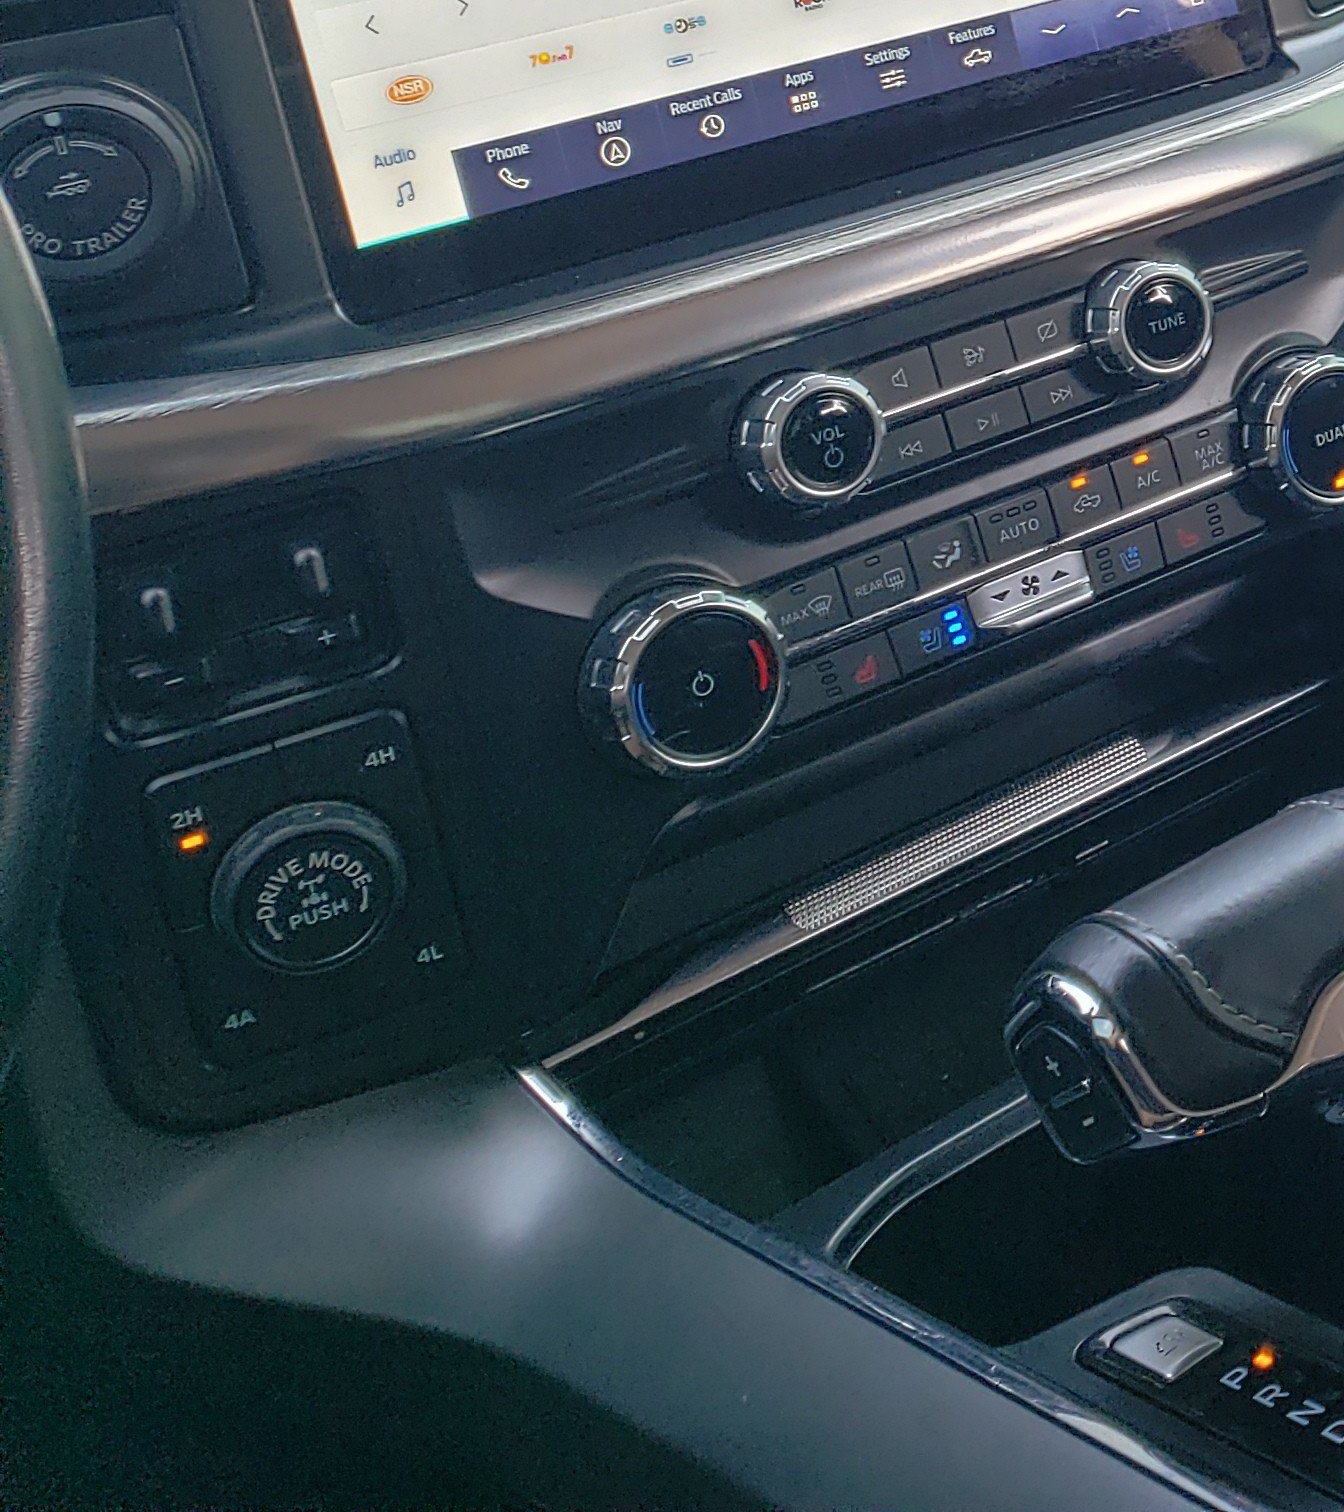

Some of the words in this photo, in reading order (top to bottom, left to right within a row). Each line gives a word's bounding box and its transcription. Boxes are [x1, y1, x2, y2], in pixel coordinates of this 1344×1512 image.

[949, 23, 996, 46] Features
[865, 44, 910, 68] Settings
[393, 79, 423, 98] NSR
[785, 68, 816, 90] Apps
[670, 94, 712, 117] Recent
[713, 86, 743, 106] Calls
[596, 117, 623, 136] Nav
[374, 146, 417, 169] Audio
[486, 140, 531, 164] Phone
[72, 196, 149, 256] TRAILER
[1147, 312, 1187, 335] TUNE
[809, 425, 846, 445] VOL
[1194, 441, 1224, 459] MAX
[1201, 452, 1225, 471] A/C
[1136, 468, 1162, 490] A/C
[999, 516, 1041, 542] AUTO
[854, 579, 884, 598] REAR
[780, 607, 810, 626] MAX
[363, 746, 397, 769] 4H
[169, 805, 204, 830] 2H
[256, 857, 305, 922] DRIVE
[308, 850, 374, 890] MODE
[288, 897, 350, 931] PUSH
[416, 944, 445, 964] 4L
[223, 1008, 257, 1030] 4A
